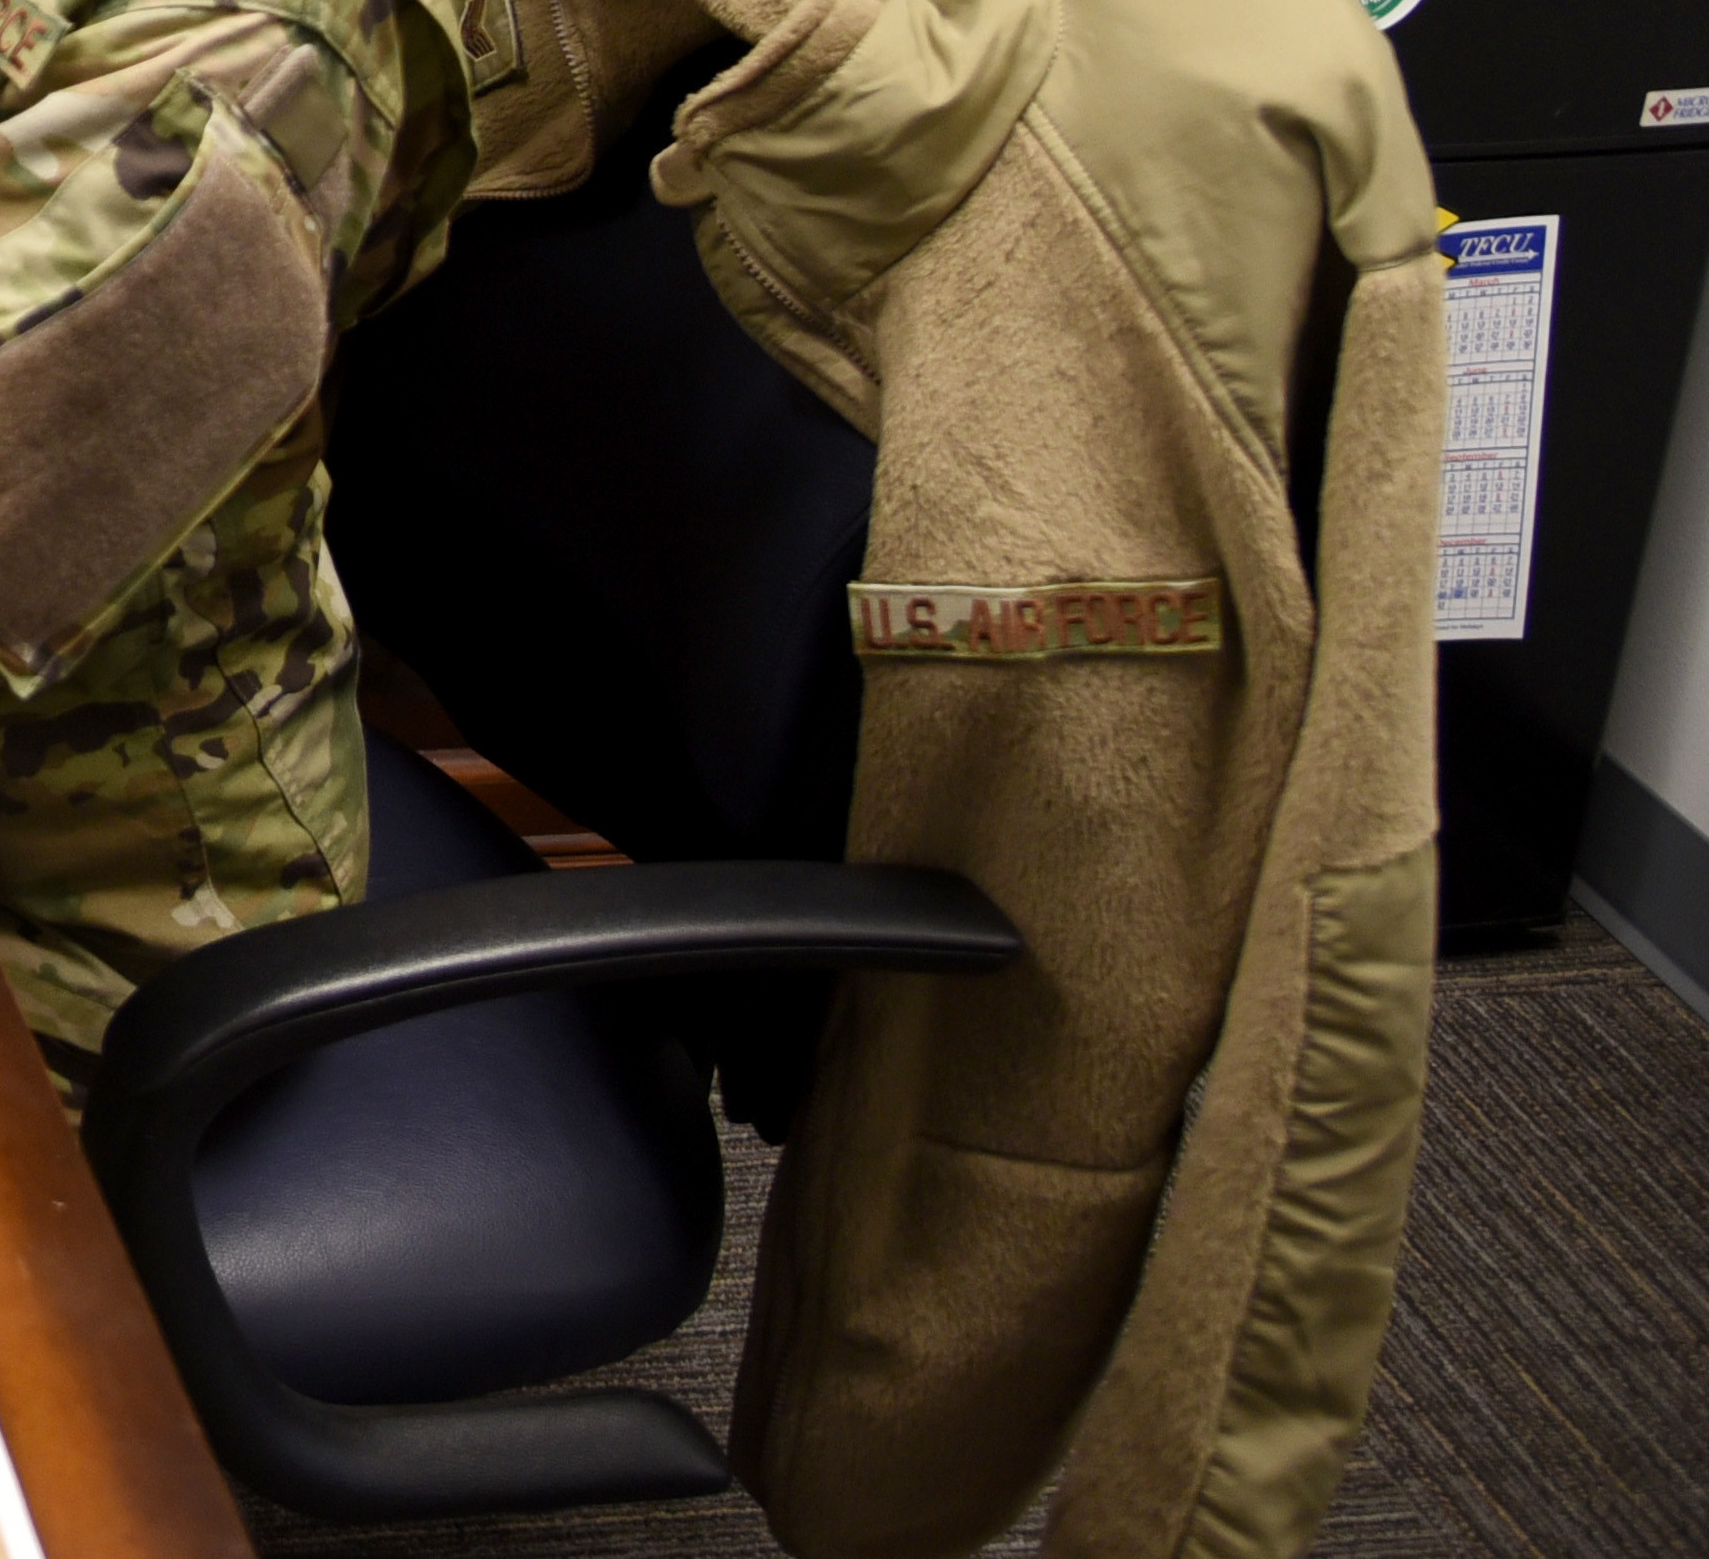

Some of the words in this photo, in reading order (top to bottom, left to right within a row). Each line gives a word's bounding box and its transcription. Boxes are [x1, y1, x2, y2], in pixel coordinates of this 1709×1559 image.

[1460, 233, 1534, 257] TFCU
[861, 598, 955, 651] U.S.
[969, 599, 1045, 652] AIR
[1056, 592, 1208, 647] FORCE
